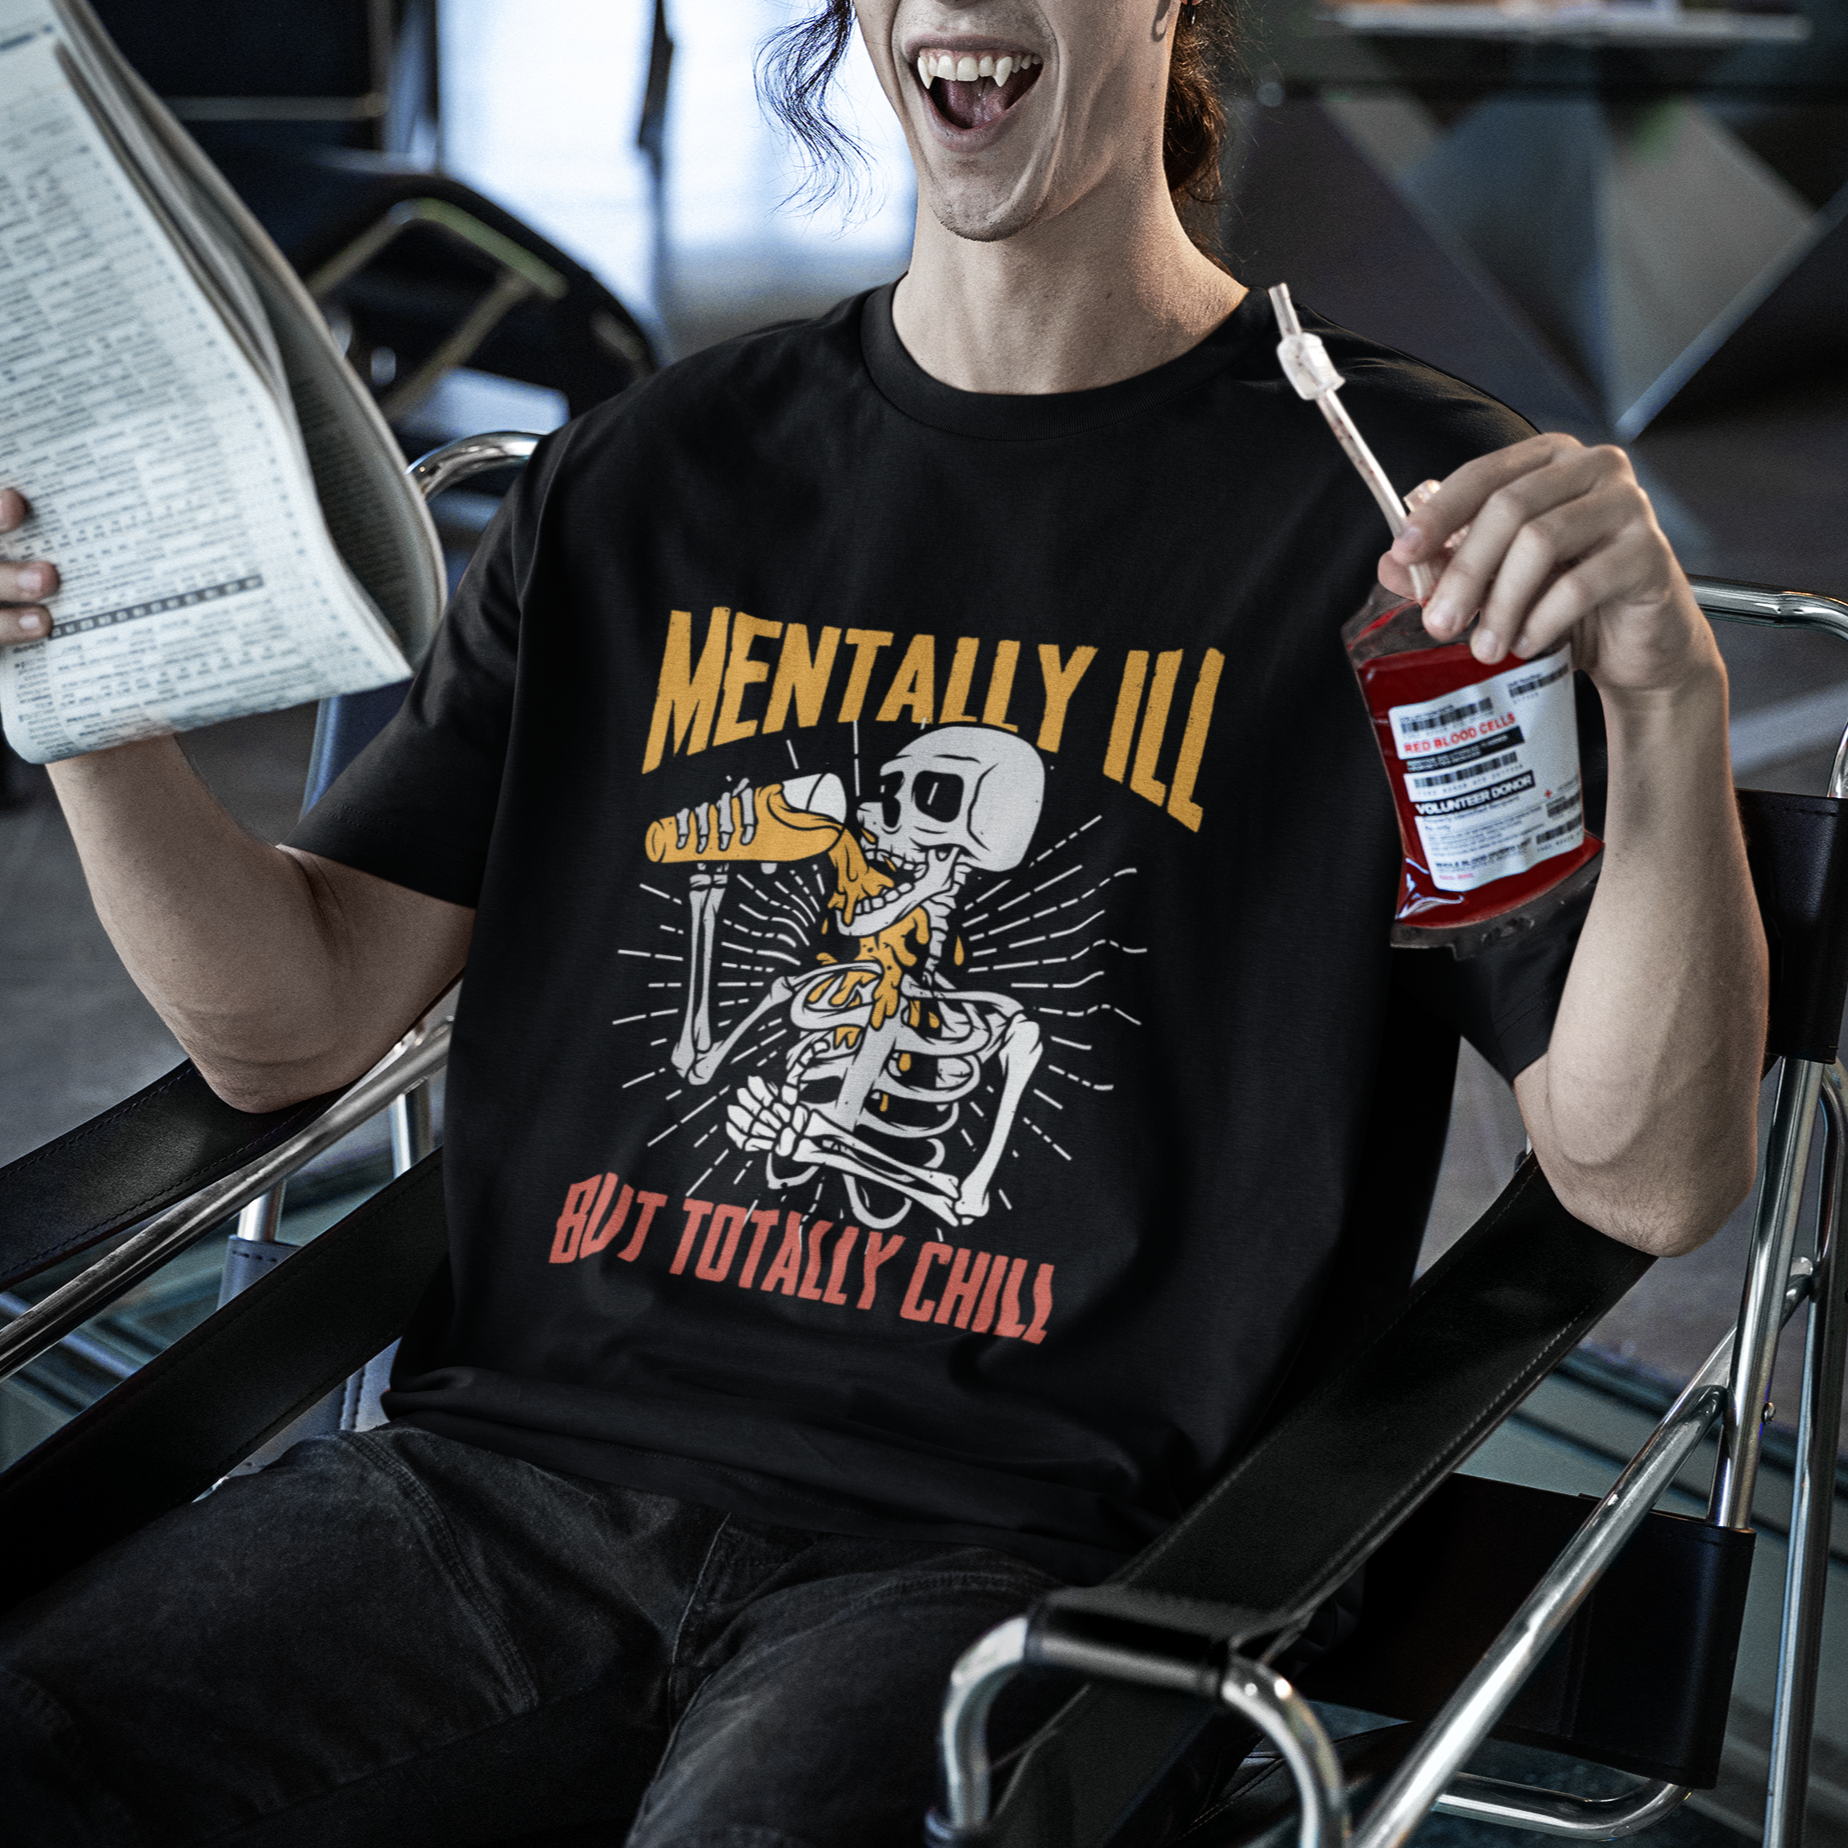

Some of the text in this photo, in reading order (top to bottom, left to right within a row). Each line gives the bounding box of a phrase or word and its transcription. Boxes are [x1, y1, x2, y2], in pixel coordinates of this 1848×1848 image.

[641, 606, 1226, 833] MENTALLY ILL
[1403, 740, 1431, 754] RED
[1434, 727, 1477, 749] BLOOD
[1479, 711, 1516, 734] CELLS
[1415, 790, 1490, 816] VOLUNTEER
[1492, 774, 1532, 798] DONOR
[548, 1172, 1055, 1345] BUT TOTALLY CHILL
